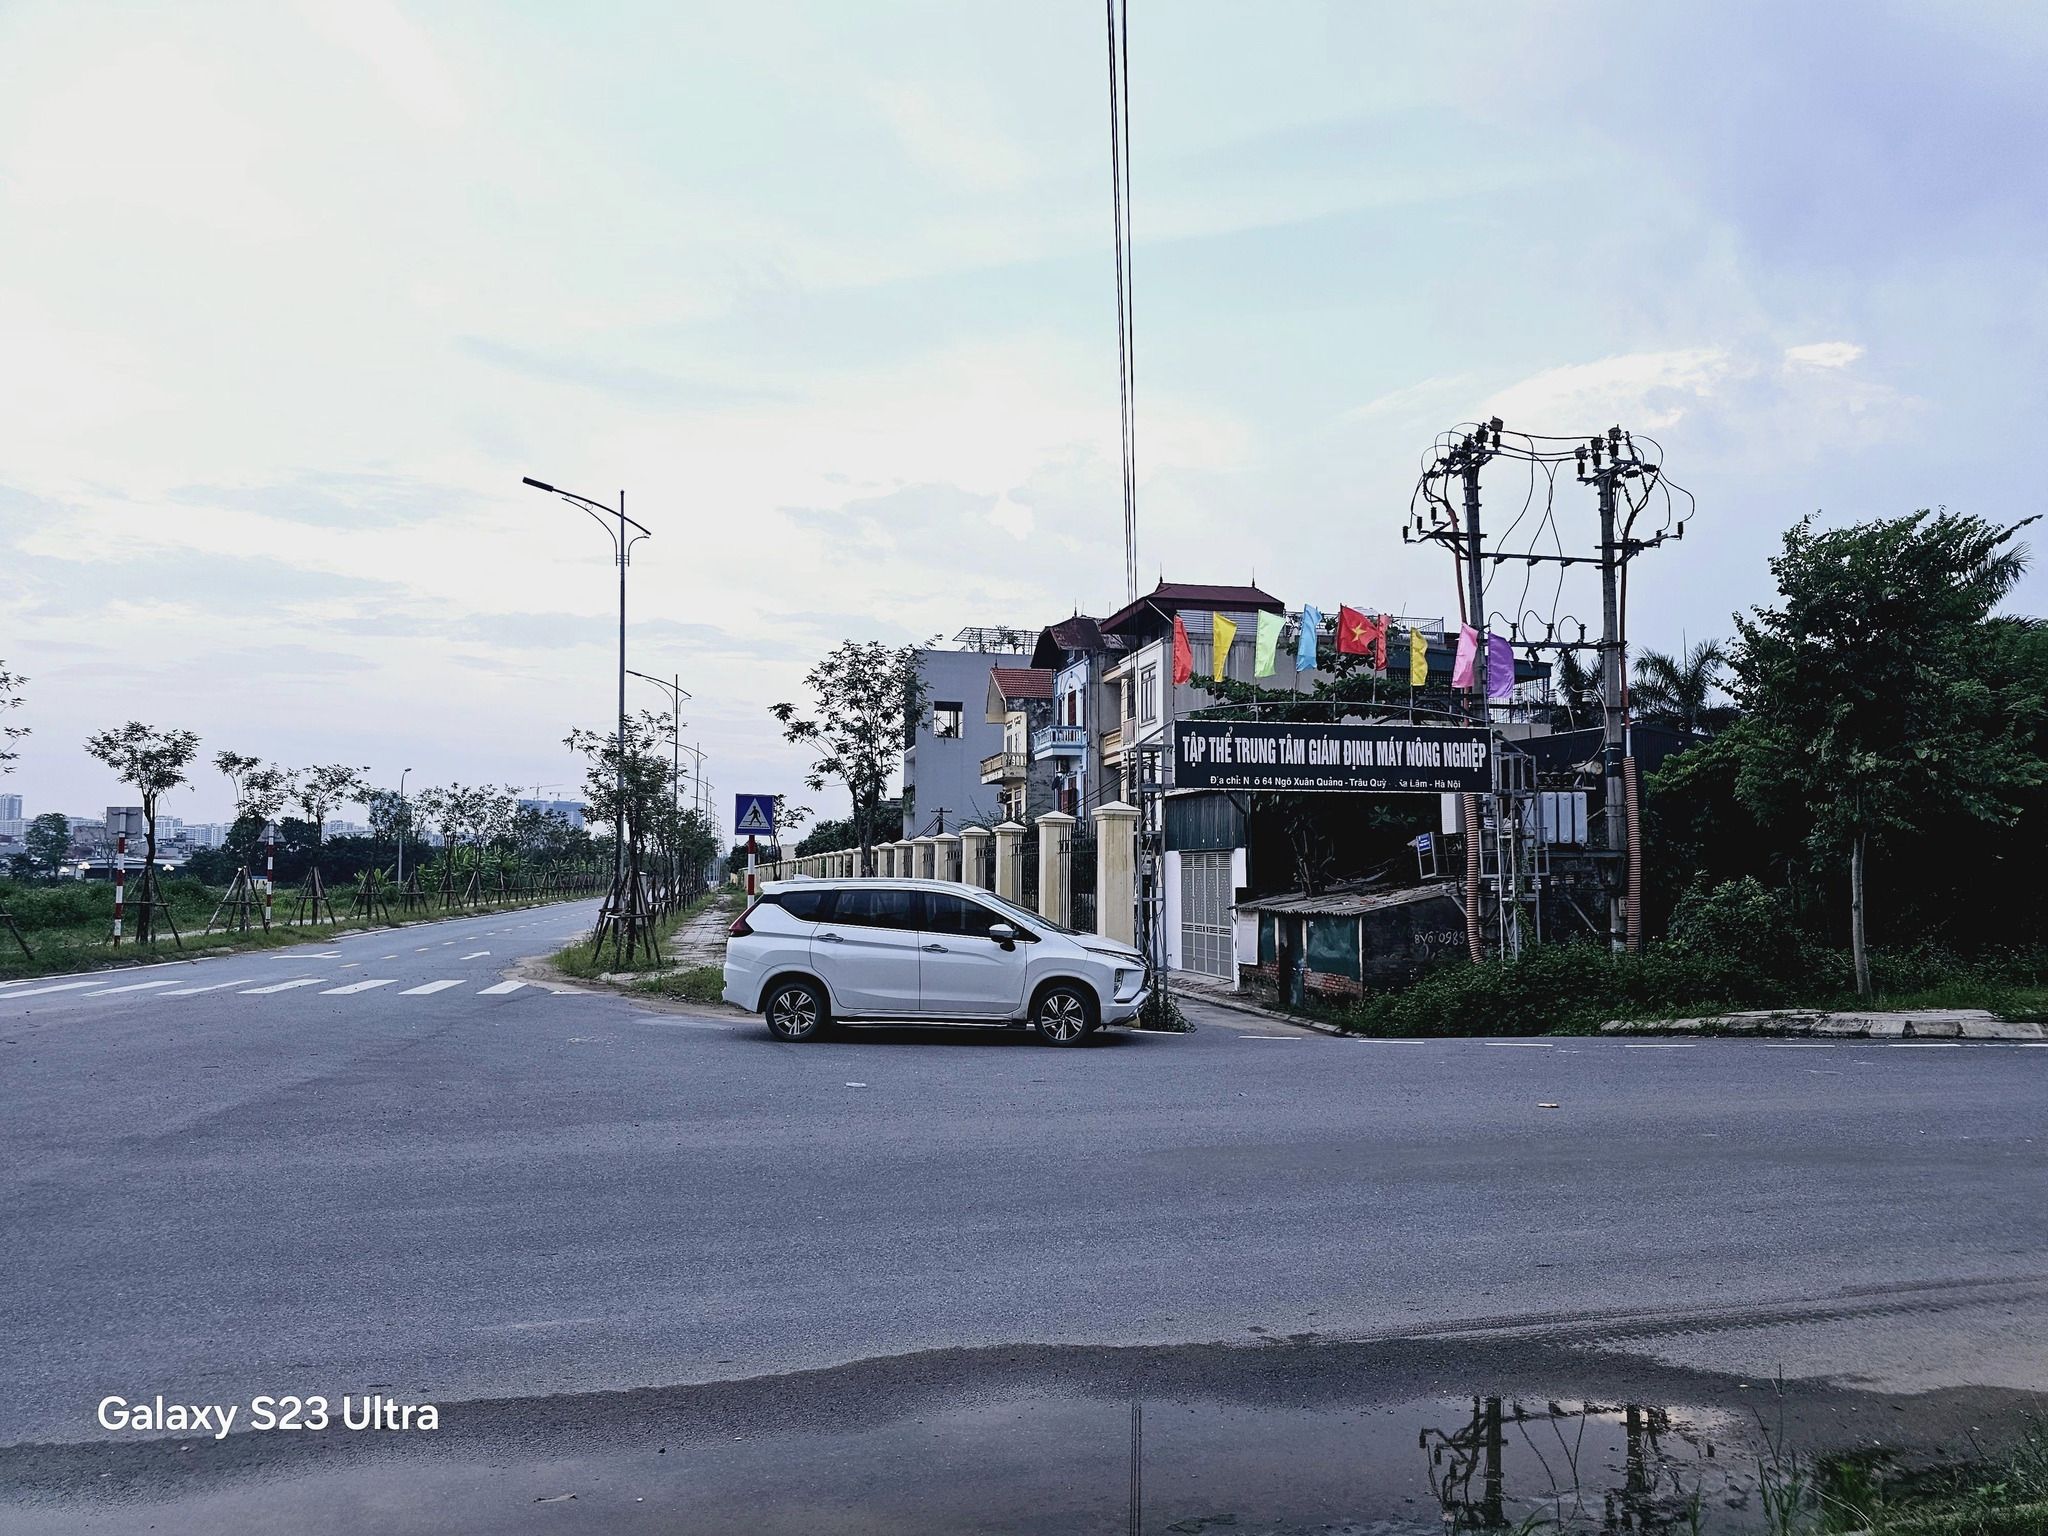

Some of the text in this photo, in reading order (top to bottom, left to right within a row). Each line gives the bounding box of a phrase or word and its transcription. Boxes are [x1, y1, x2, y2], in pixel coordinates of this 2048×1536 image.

[1182, 726, 1486, 772] TẬP THỂ TRUNG TÂM GIÁM ĐỊNH MÁY NÔNG NGHIỆP
[1243, 776, 1260, 785] Nõ
[1262, 776, 1272, 785] 64
[1293, 777, 1314, 786] Xuân
[1349, 778, 1368, 787] Trâu
[1410, 779, 1428, 788] Lâm
[1434, 779, 1445, 788] Hà
[1447, 780, 1461, 790] Nội
